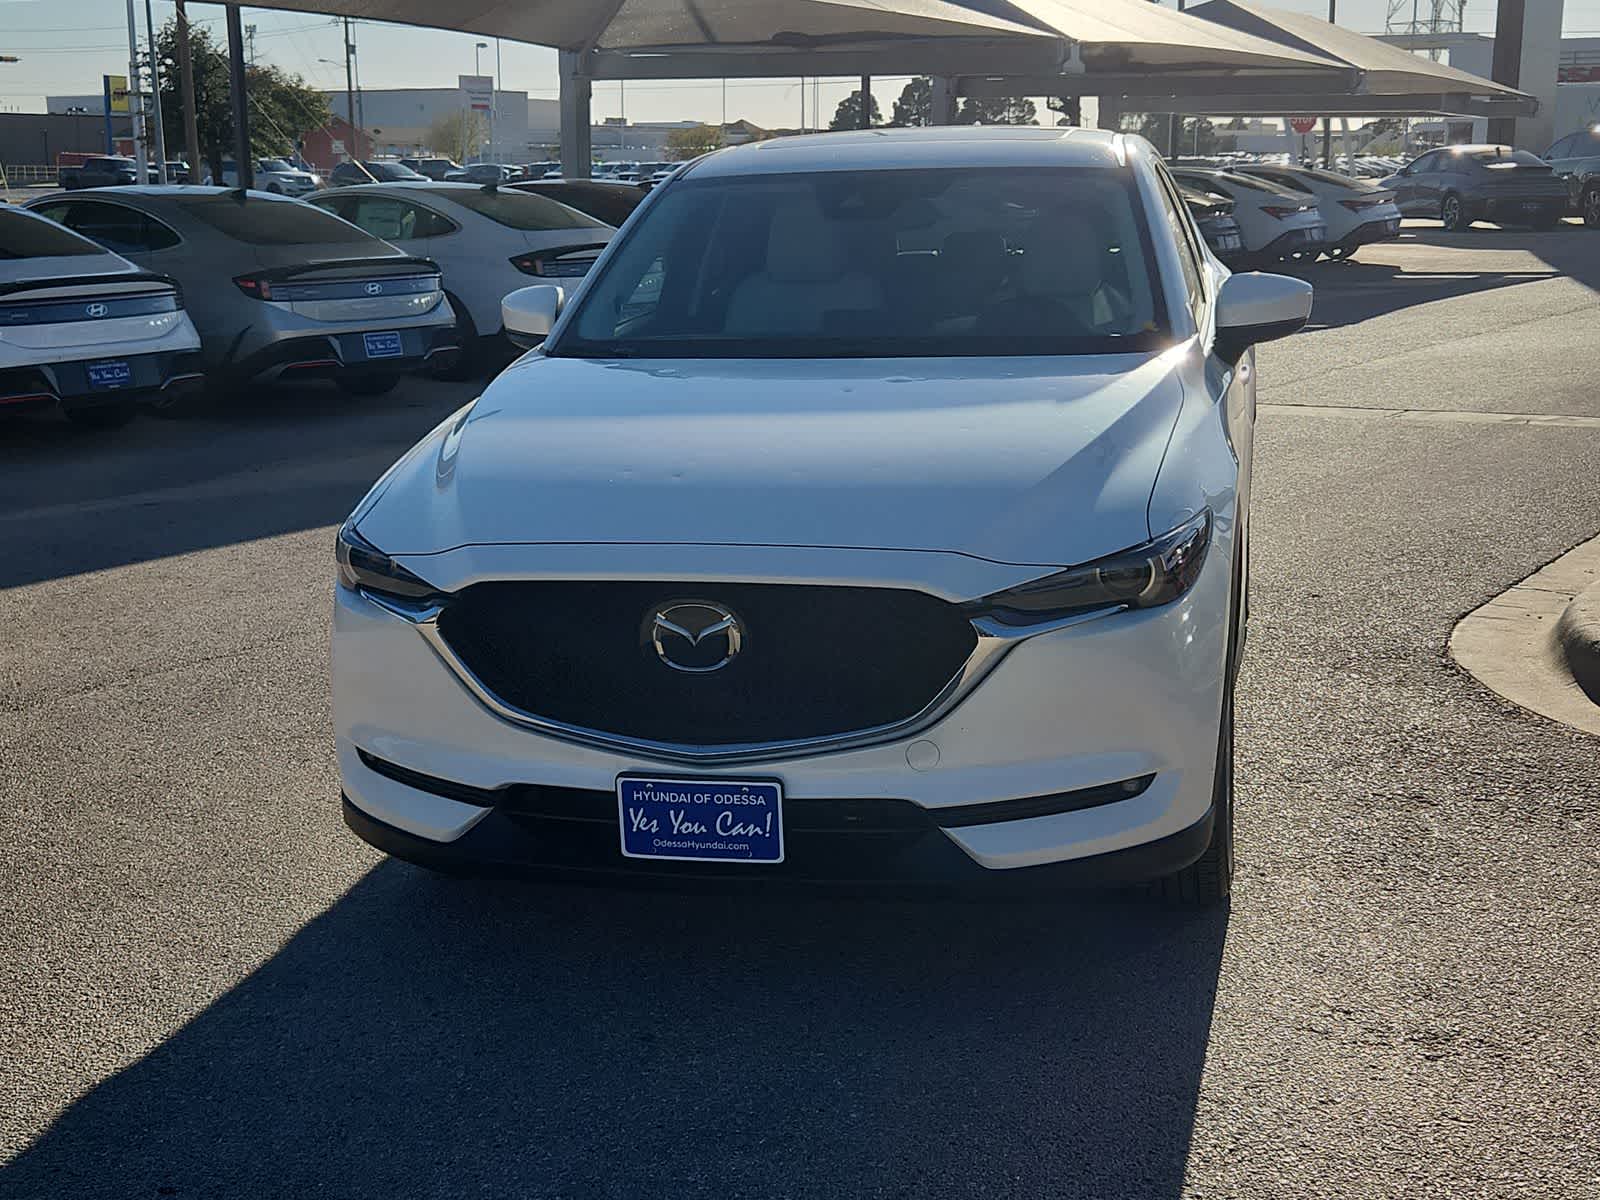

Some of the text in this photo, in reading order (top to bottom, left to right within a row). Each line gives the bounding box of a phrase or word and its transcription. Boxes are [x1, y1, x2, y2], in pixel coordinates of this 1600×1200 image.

[634, 791, 766, 806] HYUNDAI OF ODESSA
[629, 808, 773, 837] Yes You Can!
[653, 838, 749, 850] OdessaHyundai.com
